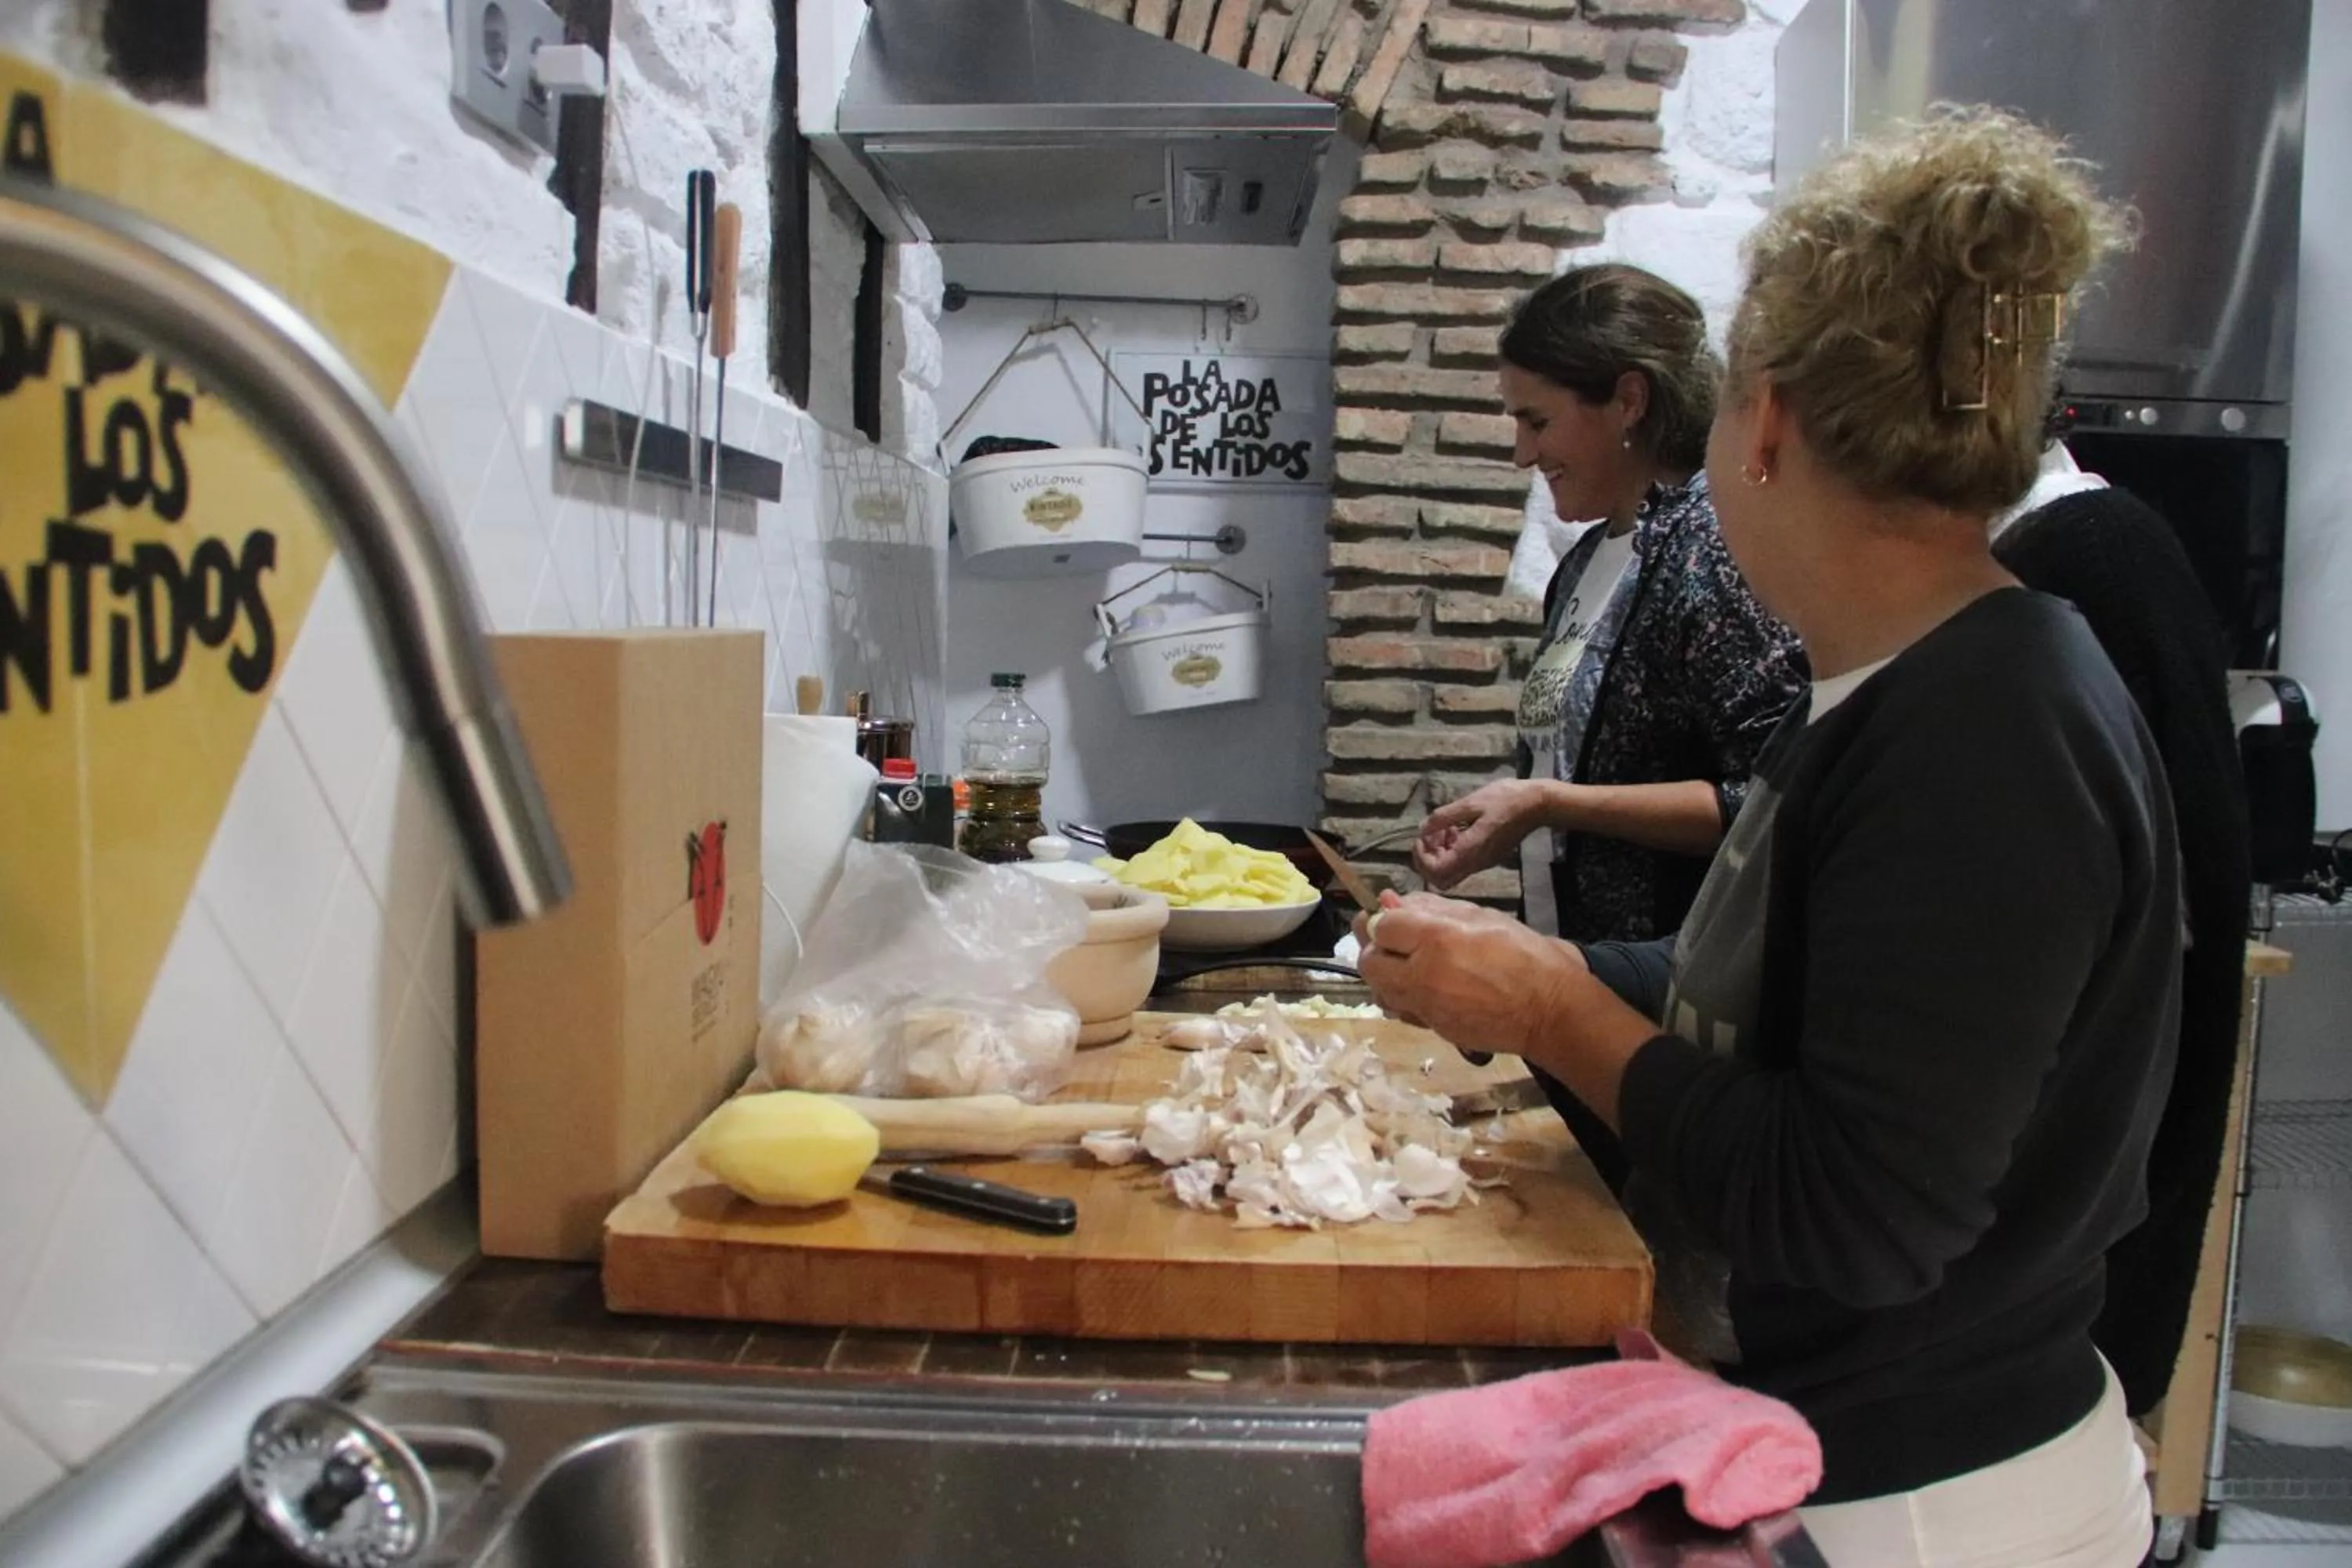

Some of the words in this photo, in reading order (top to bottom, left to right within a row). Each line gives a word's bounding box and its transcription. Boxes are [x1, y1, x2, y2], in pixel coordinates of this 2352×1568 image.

[1182, 359, 1222, 386] LA
[1144, 372, 1281, 417] POSADA
[1161, 409, 1197, 445] DE
[1220, 410, 1272, 439] LOS
[64, 386, 194, 522] LOS
[1010, 473, 1084, 493] Welcome
[1161, 641, 1225, 662] Welcome
